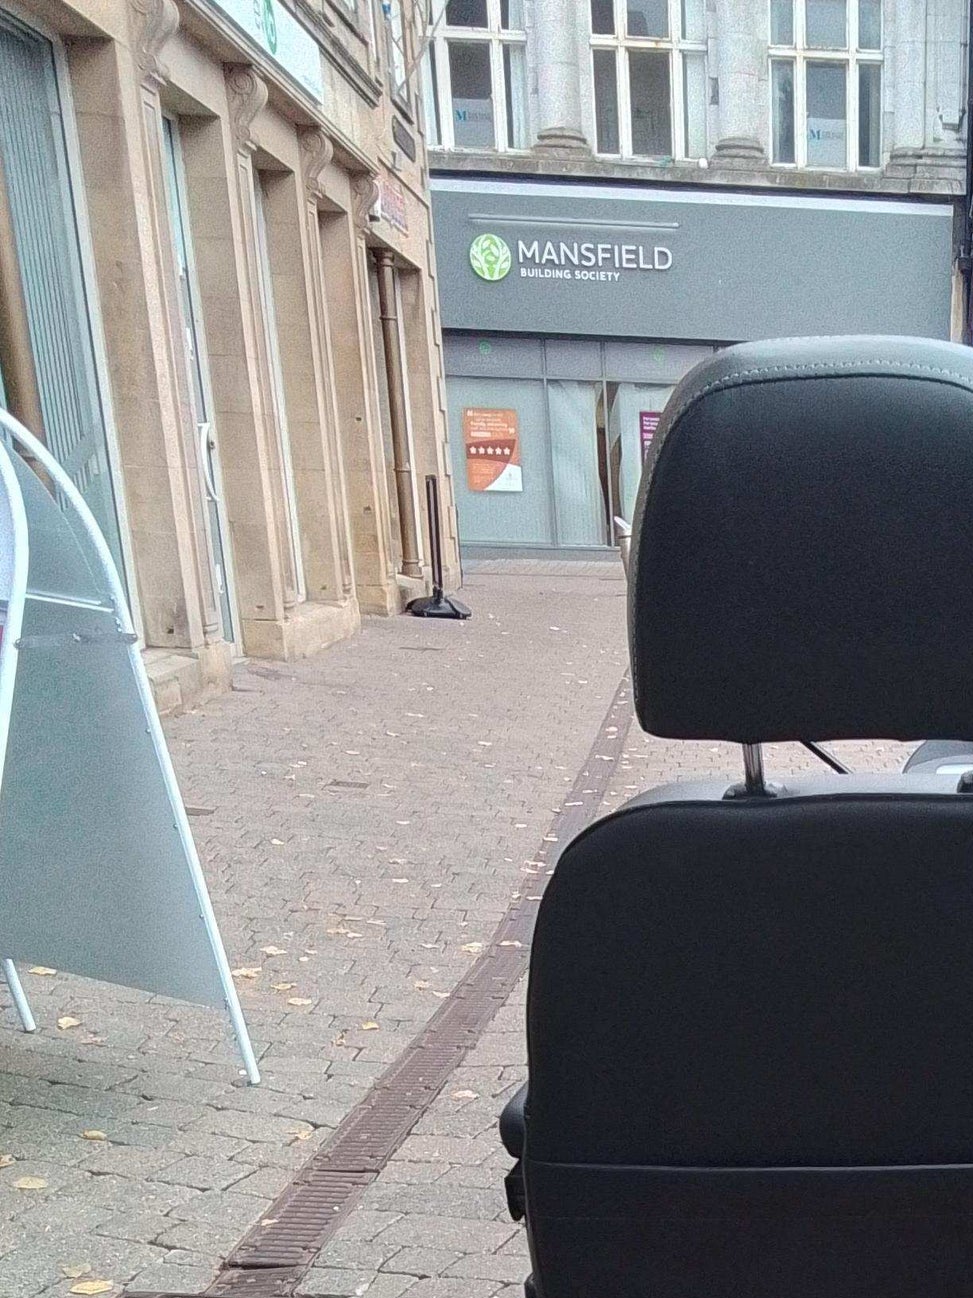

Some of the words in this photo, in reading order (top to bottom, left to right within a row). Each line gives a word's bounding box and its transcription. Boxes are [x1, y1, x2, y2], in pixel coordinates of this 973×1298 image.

[517, 239, 673, 270] MANSFIELD
[520, 267, 572, 280] BUILDING
[574, 270, 620, 282] SOCIETY
